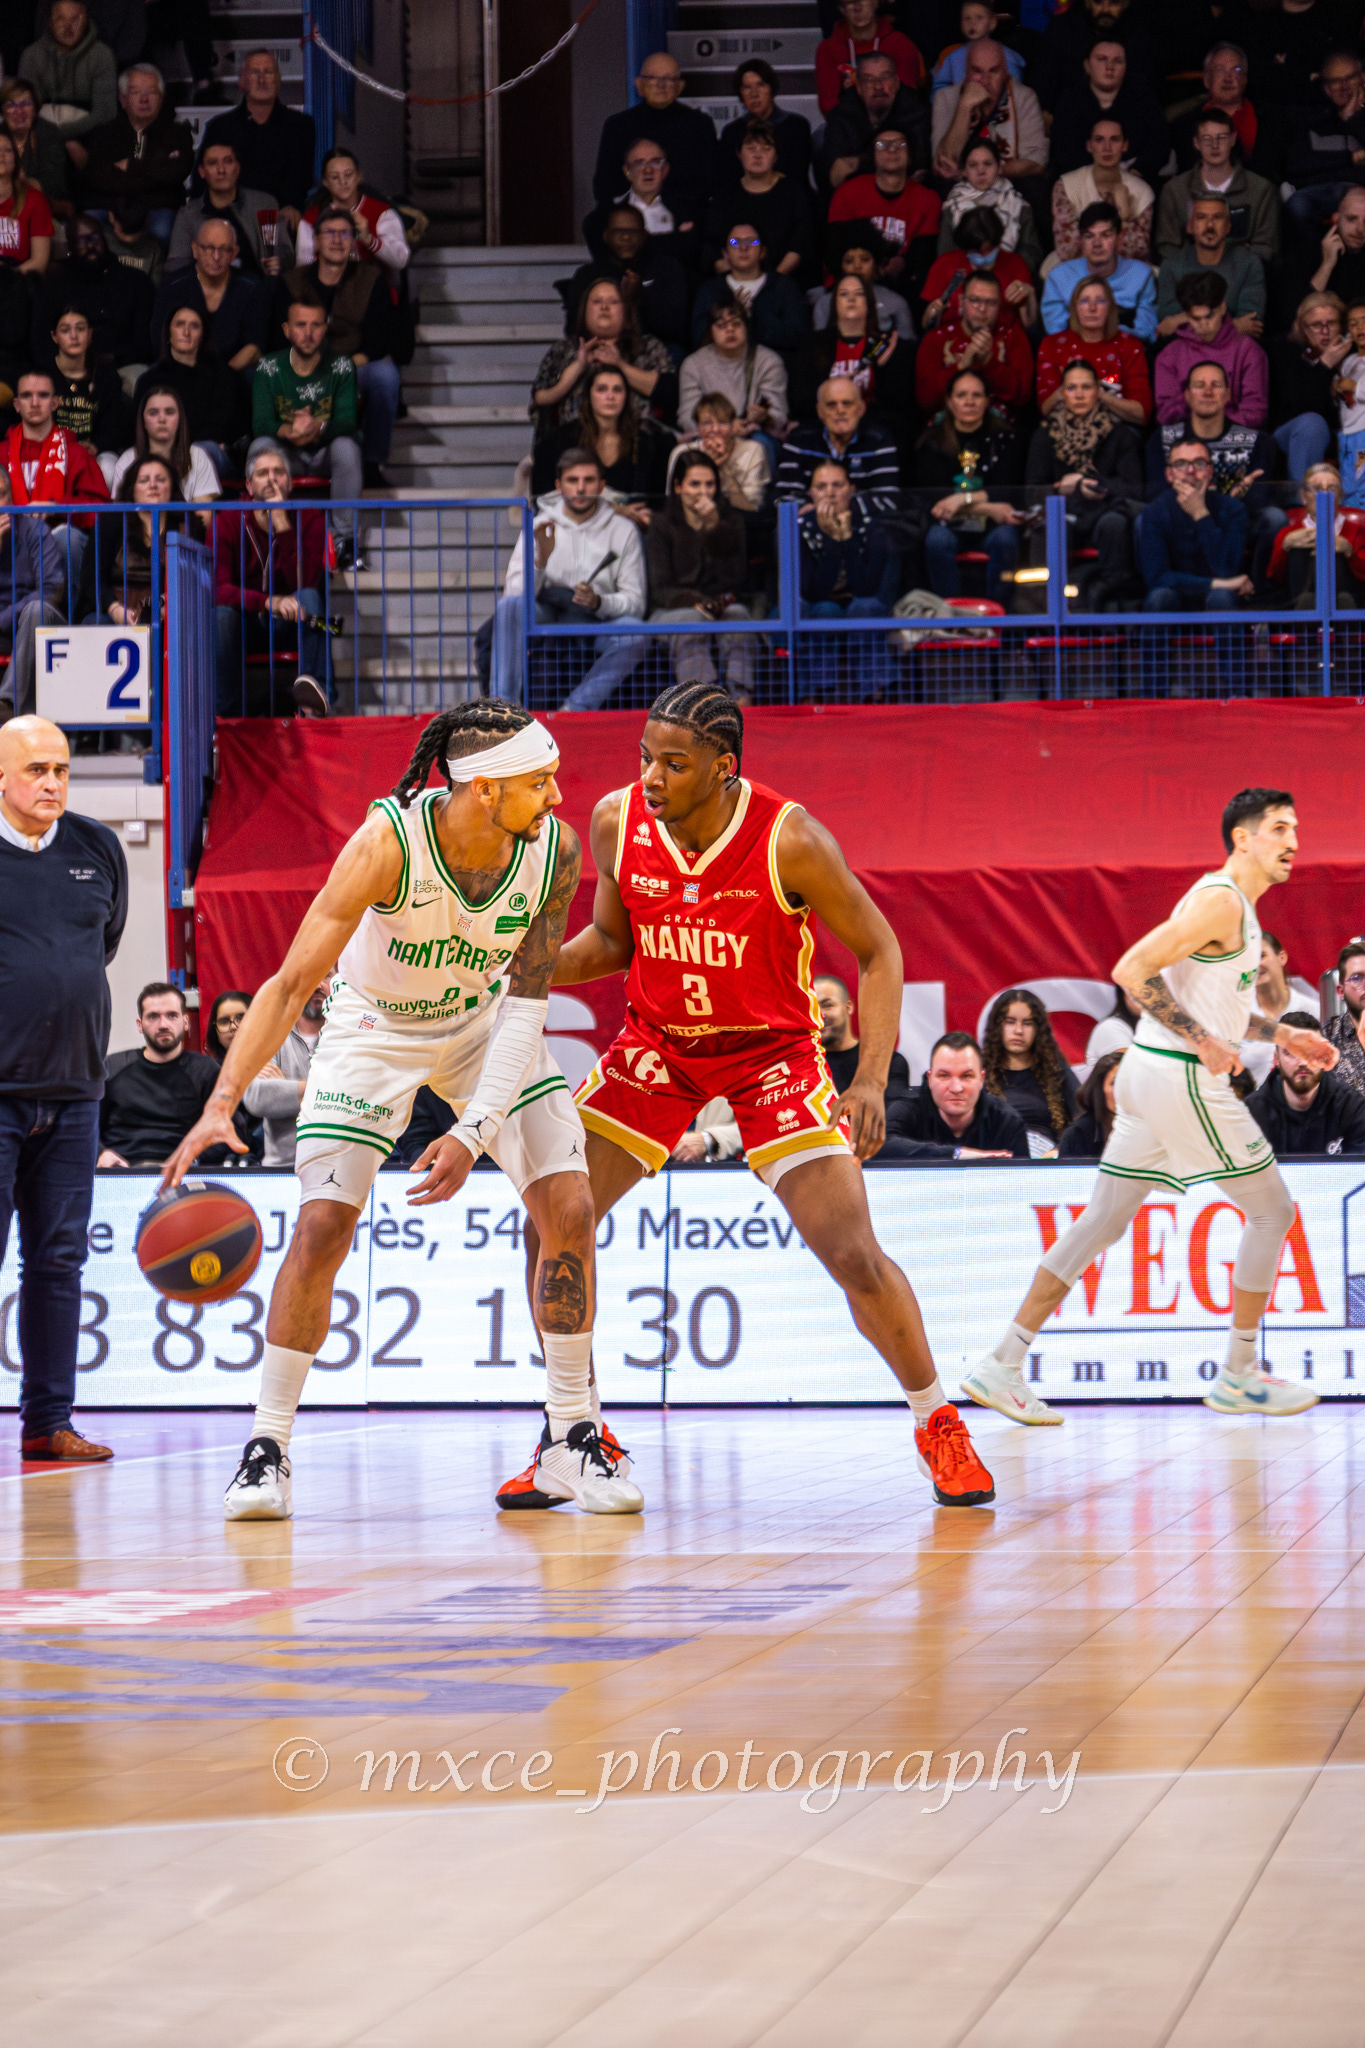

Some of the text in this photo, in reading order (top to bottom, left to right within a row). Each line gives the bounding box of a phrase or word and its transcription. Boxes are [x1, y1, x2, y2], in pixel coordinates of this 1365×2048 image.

[45, 638, 140, 709] F 2
[631, 873, 669, 890] FCGE
[664, 914, 716, 927] GRAND
[637, 924, 750, 969] NANCY
[682, 973, 713, 1016] 3
[671, 1027, 695, 1035] BTP
[755, 1079, 808, 1107] EIFFAGE
[153, 1290, 266, 1373] 83
[623, 1286, 742, 1369] 30
